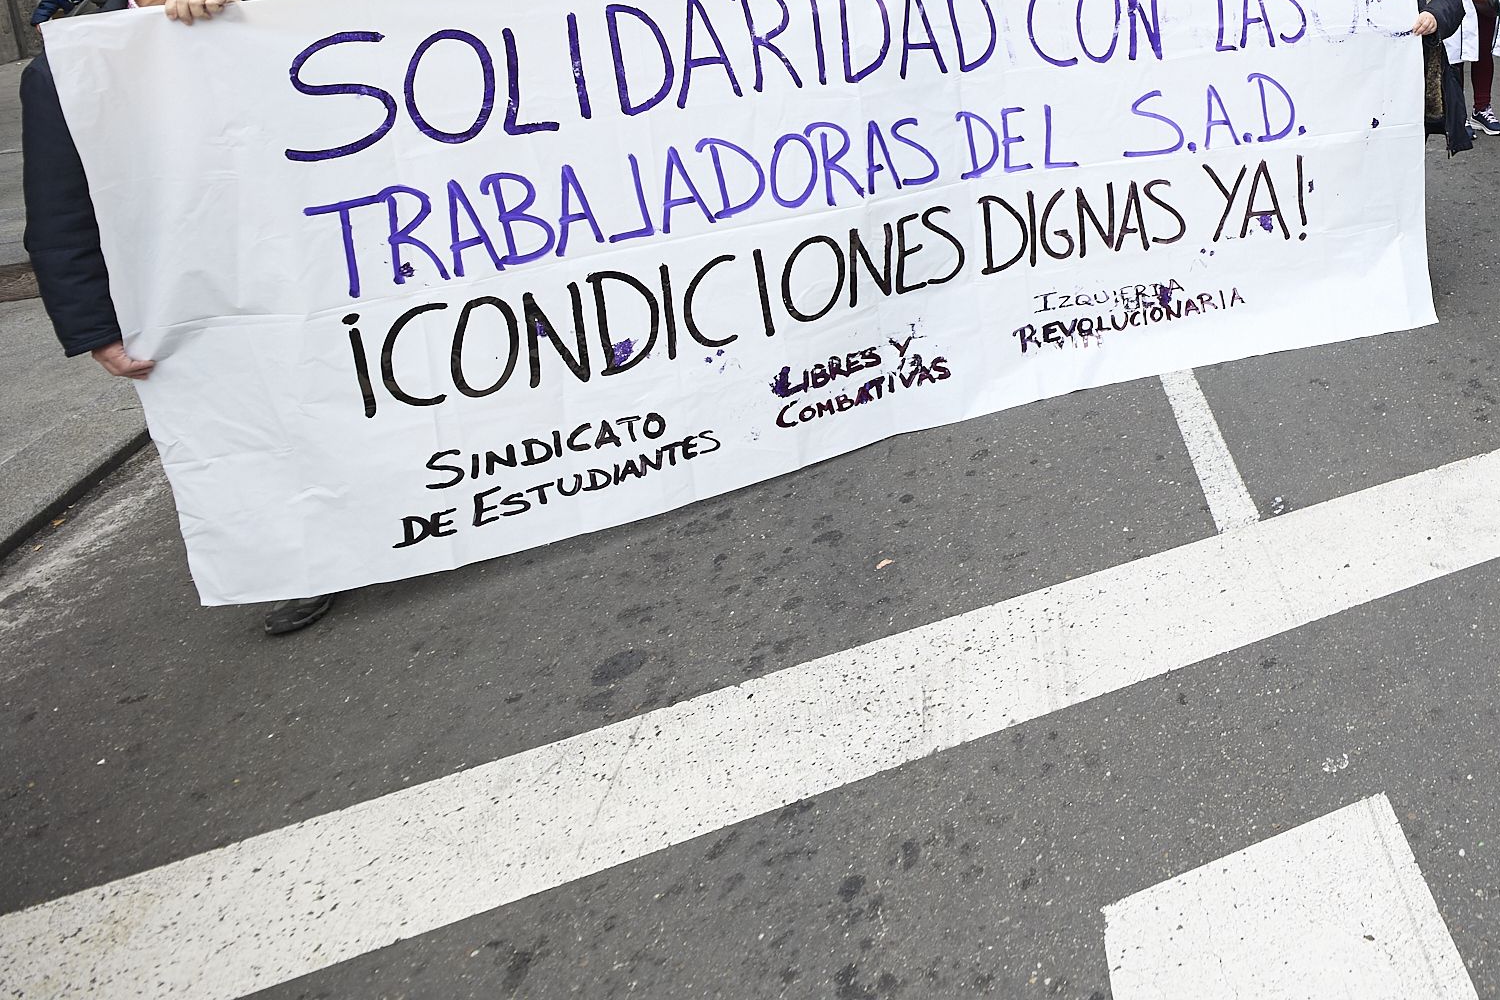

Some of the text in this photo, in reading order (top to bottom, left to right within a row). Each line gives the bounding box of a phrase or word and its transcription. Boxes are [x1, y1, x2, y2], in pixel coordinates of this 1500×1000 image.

[303, 72, 1308, 298] TRABAJADORAS DEL S.A.D.
[977, 178, 1187, 276] DIGNAS
[1202, 154, 1309, 242] YA!
[1013, 287, 1246, 354] REVOLUCIONARIA
[771, 334, 914, 399] LIBRES Y
[775, 356, 952, 429] COMBATIVAS
[392, 429, 721, 549] DE ESTUDIANTES
[425, 411, 667, 490] SINDICATO
